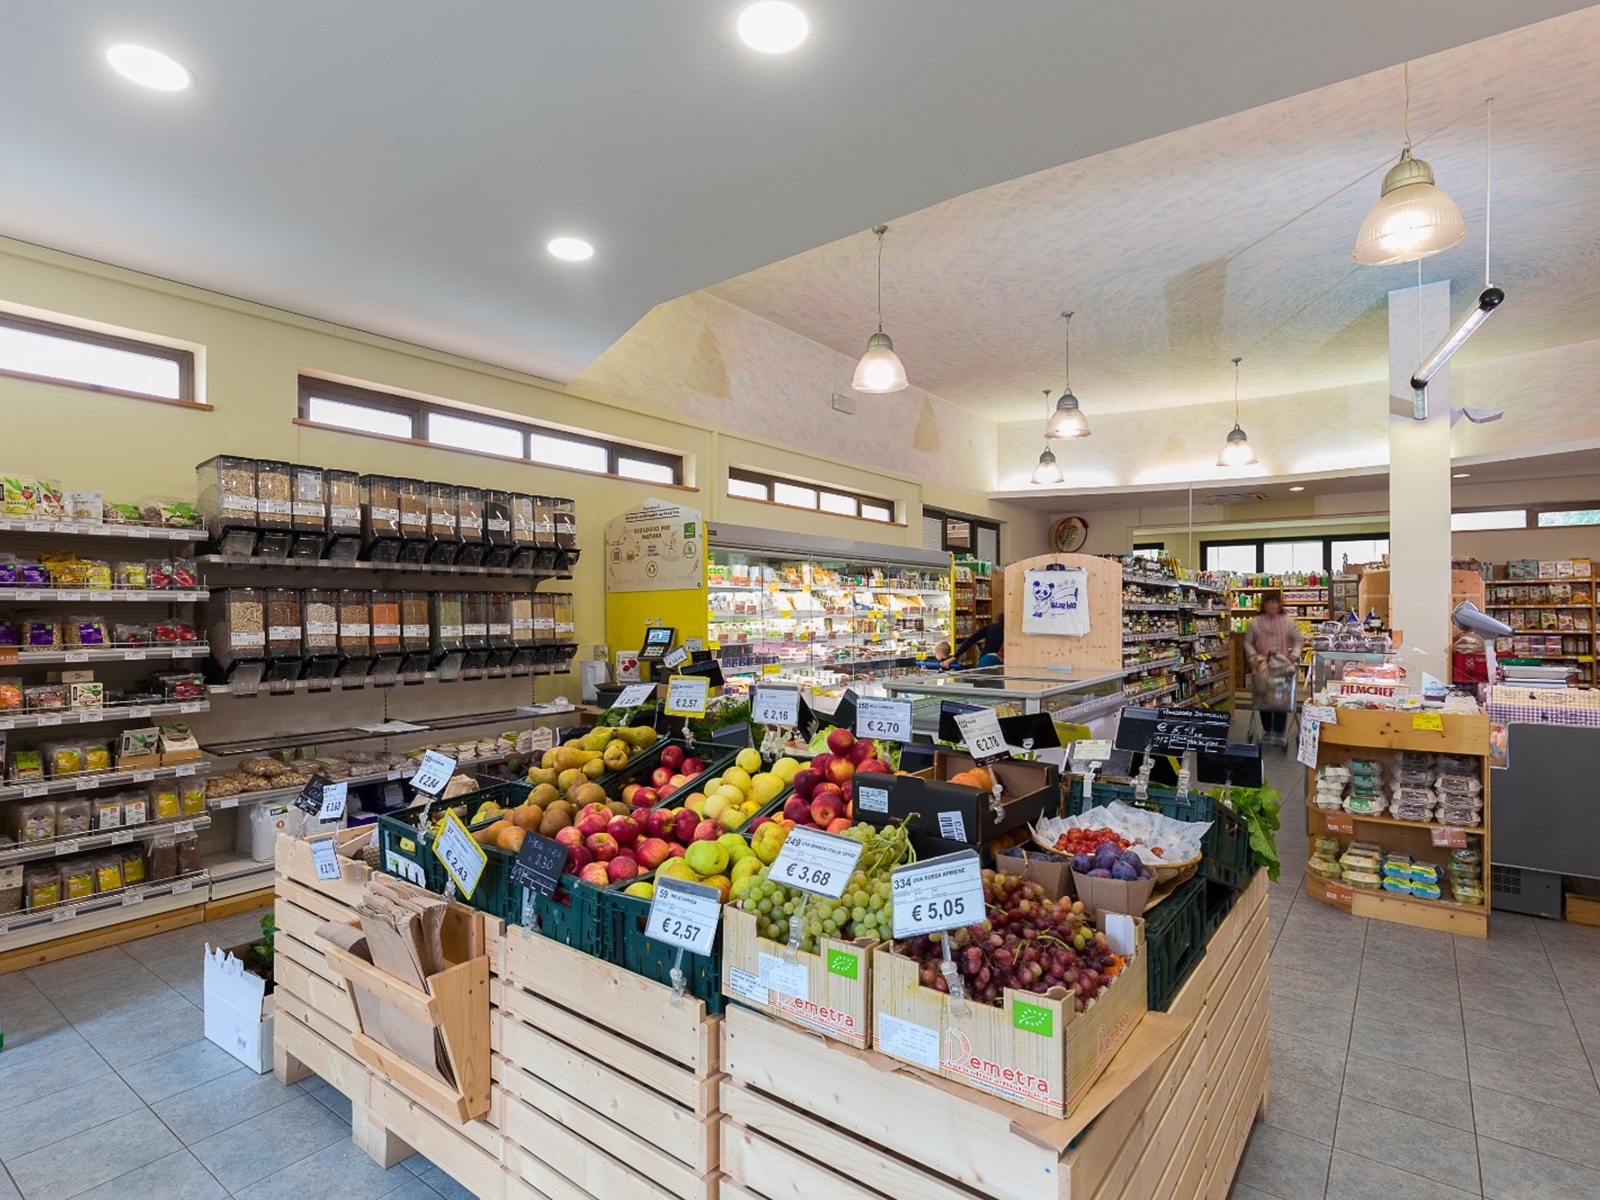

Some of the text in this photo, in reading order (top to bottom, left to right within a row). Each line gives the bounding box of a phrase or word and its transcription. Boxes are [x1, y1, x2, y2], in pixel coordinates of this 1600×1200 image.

[1340, 685, 1395, 698] FILMCHEF
[682, 699, 698, 708] 2,57
[771, 709, 789, 721] 2,16
[867, 720, 899, 734] € 2,70
[1156, 722, 1168, 733] €
[982, 735, 1001, 751] 2,78
[784, 836, 802, 848] 249
[451, 857, 469, 882] 2,43
[785, 862, 831, 887] € 3,68
[893, 877, 911, 890] 334
[911, 896, 965, 922] € 5,05
[662, 917, 701, 942] € 2,57
[944, 1027, 1049, 1094] Demetra
